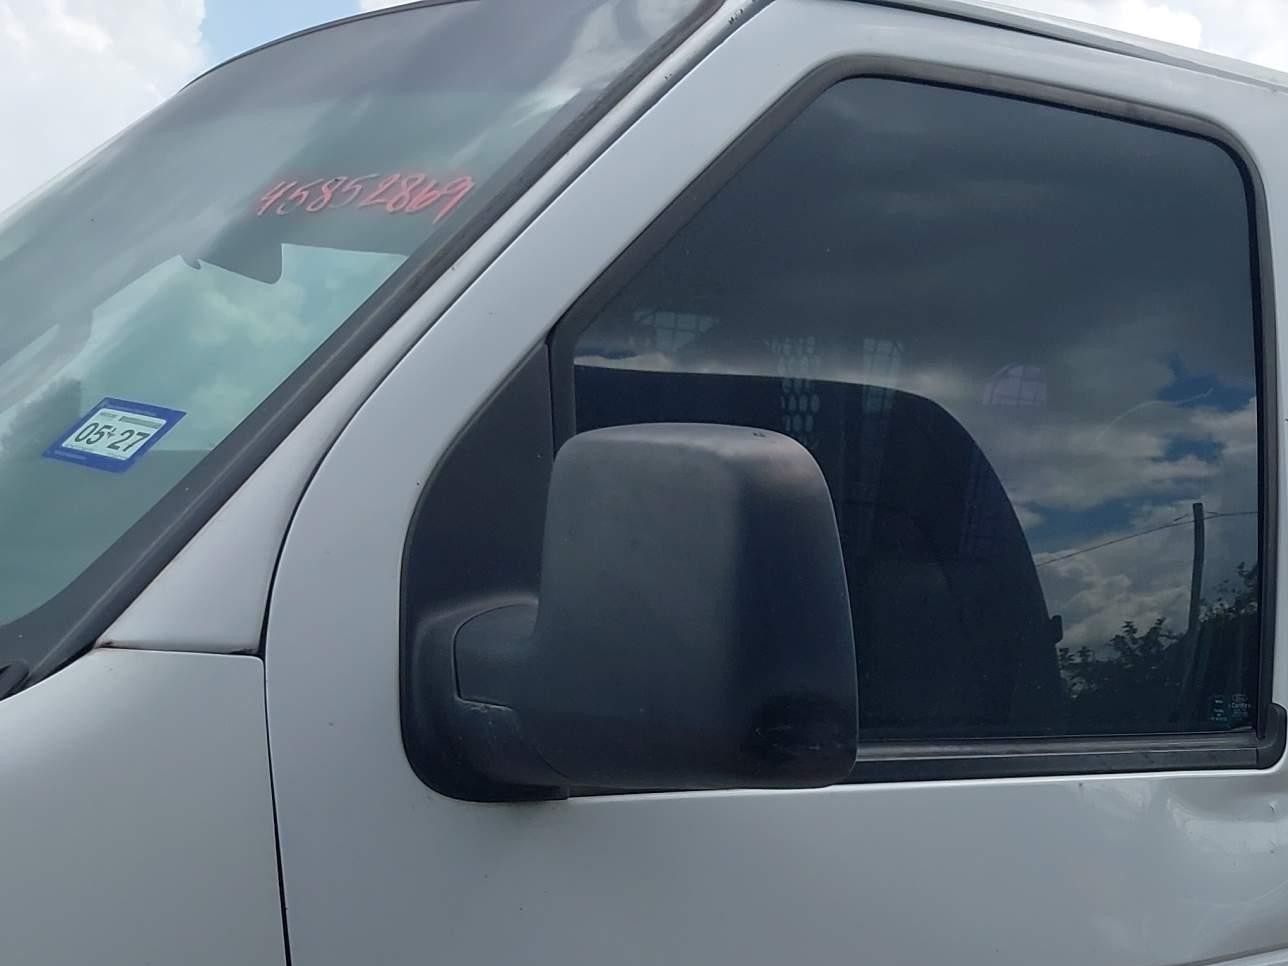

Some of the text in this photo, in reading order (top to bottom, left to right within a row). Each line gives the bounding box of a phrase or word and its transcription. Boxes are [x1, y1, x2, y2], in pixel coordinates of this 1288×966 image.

[257, 173, 474, 224] 45852869
[74, 422, 112, 445] 05
[107, 429, 151, 452] 27
